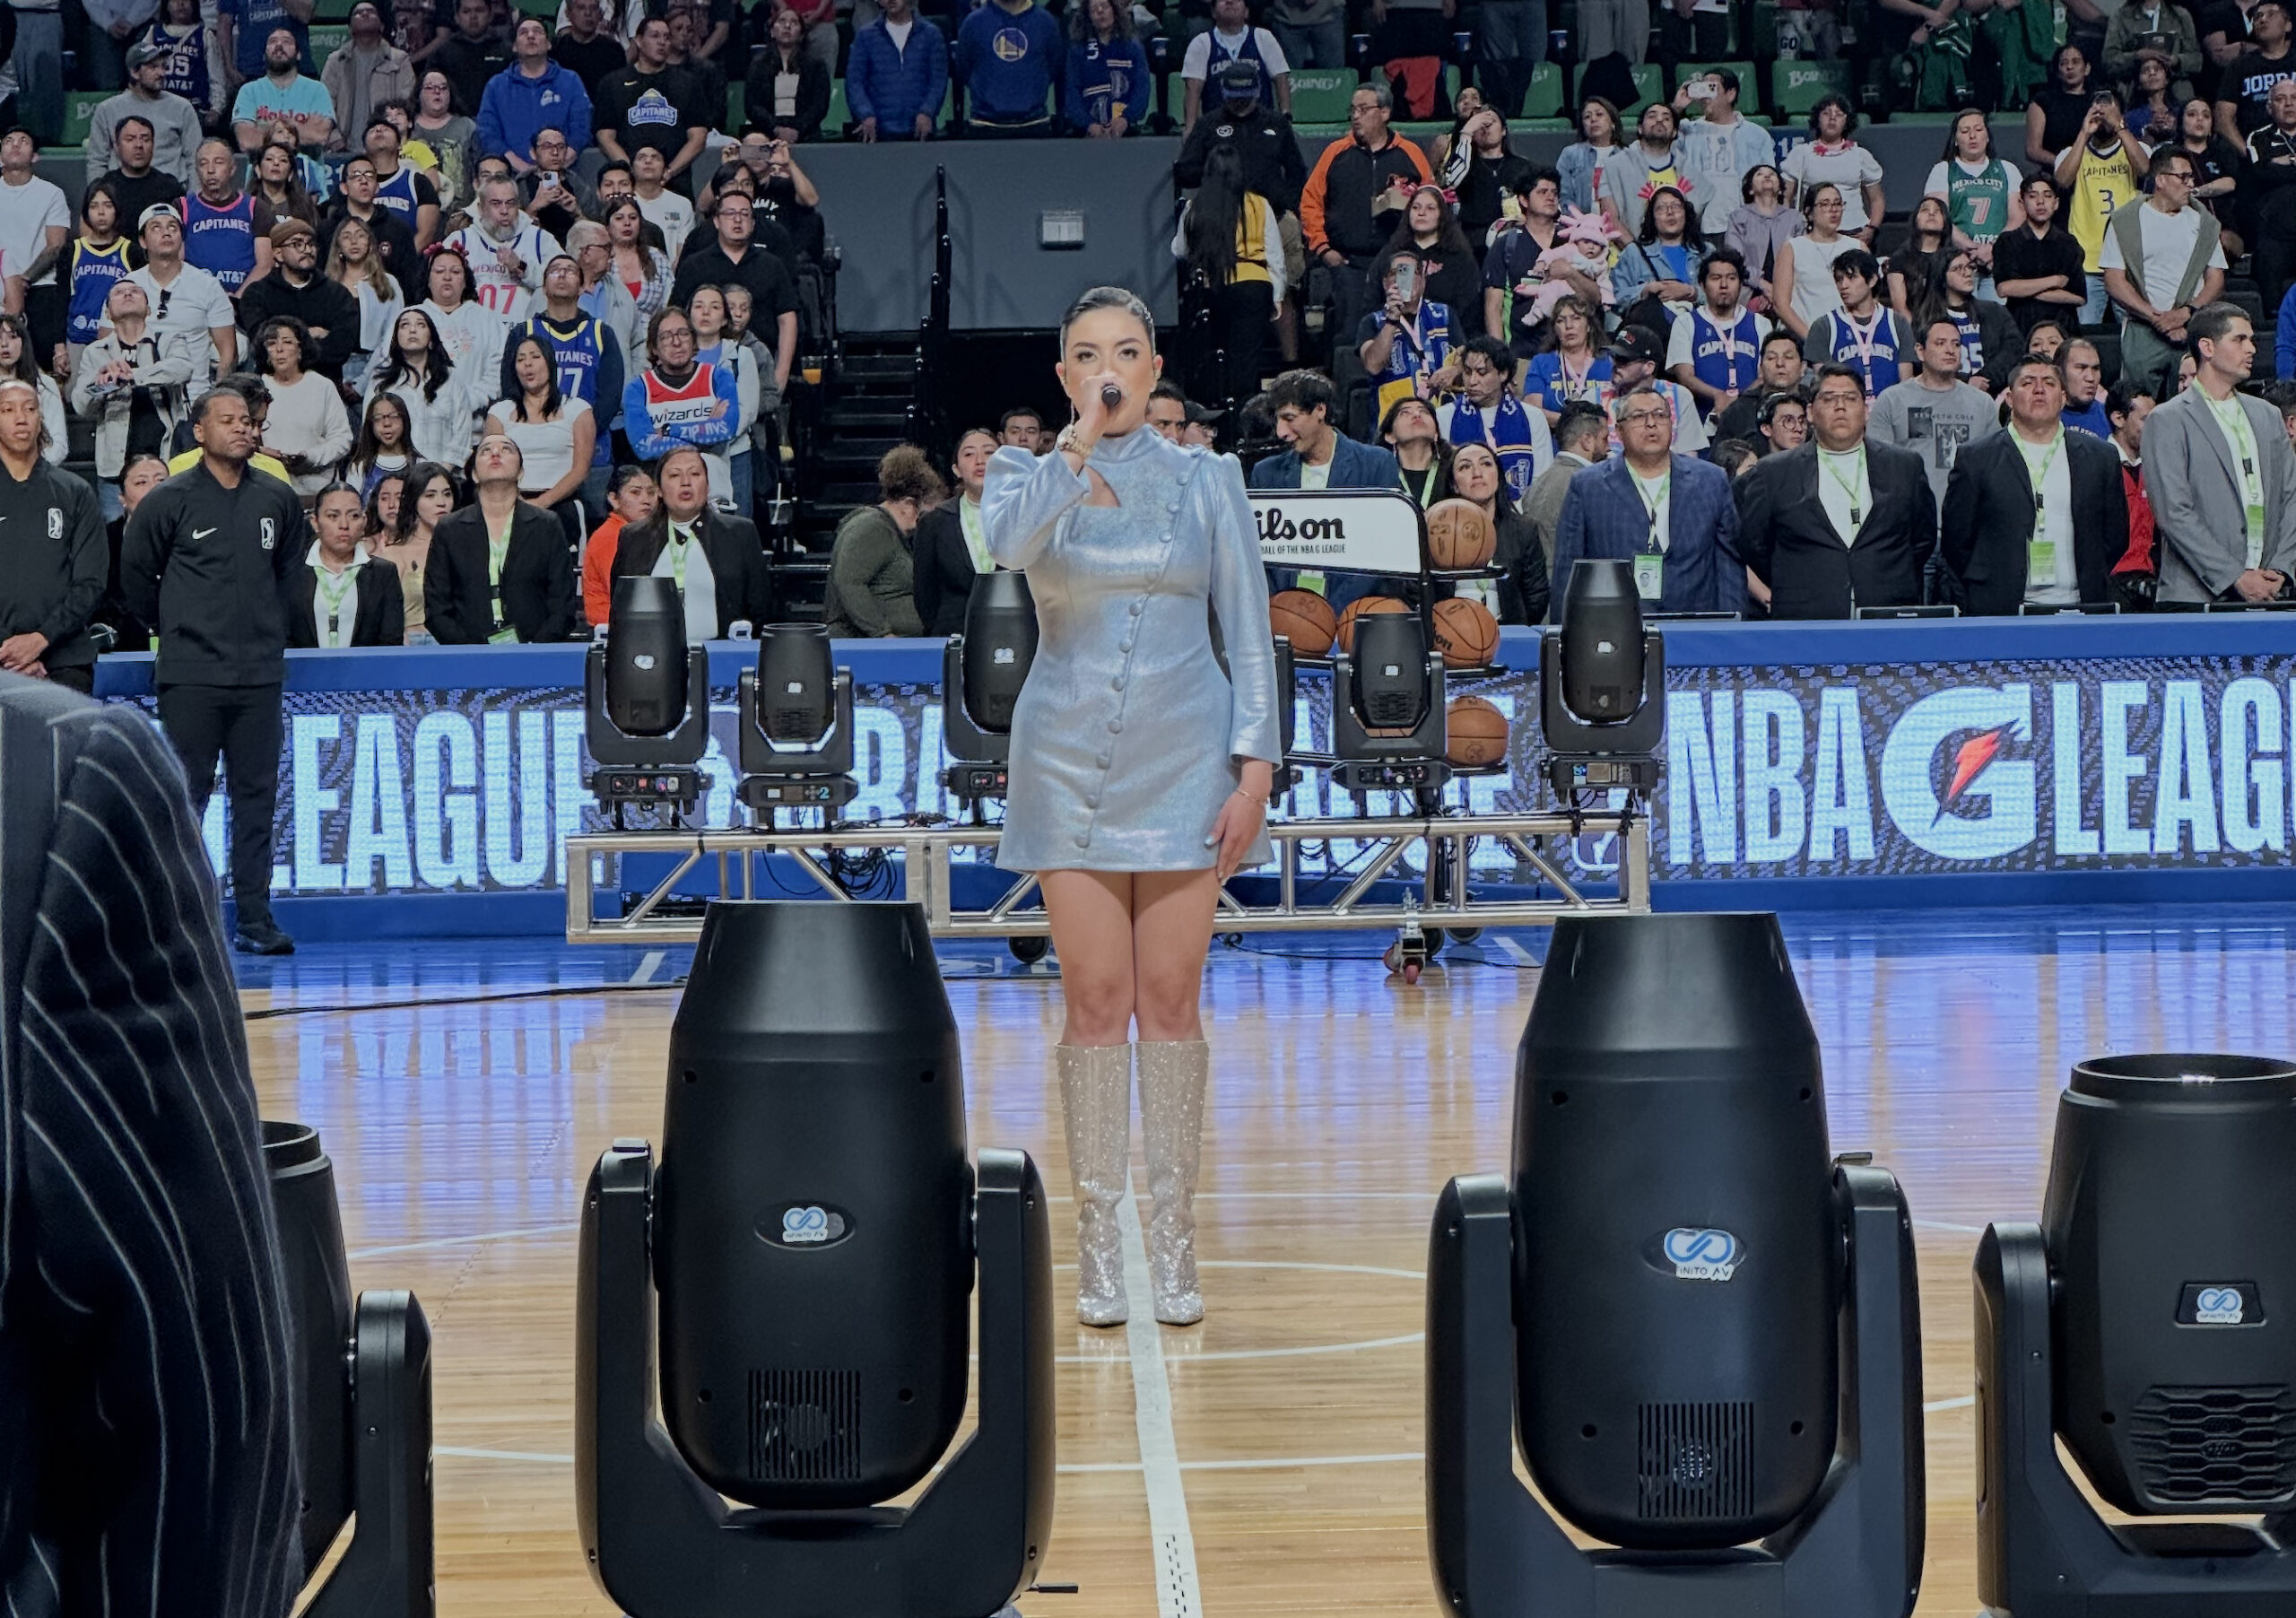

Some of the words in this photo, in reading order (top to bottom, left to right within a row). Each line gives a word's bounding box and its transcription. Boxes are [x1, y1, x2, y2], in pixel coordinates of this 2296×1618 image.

[631, 106, 675, 119] CAPITANES
[1952, 178, 1985, 192] MEXICO
[1985, 178, 2004, 189] CITY
[1966, 197, 1992, 225] 7
[2099, 188, 2115, 215] 3
[192, 218, 250, 234] CAPITANES
[216, 270, 247, 284] AT&T
[649, 402, 713, 425] wizards
[1254, 508, 1346, 541] ilson
[1277, 545, 1286, 554] OF
[1286, 544, 1299, 554] THE
[1300, 544, 1314, 553] NBA
[1315, 544, 1321, 553] G
[1322, 544, 1346, 553] LEAGUE
[1667, 686, 1875, 865] NBA
[1881, 676, 2038, 861] G
[2052, 676, 2296, 857] LEAG
[270, 709, 604, 891] EAGUE
[815, 785, 831, 800] 2
